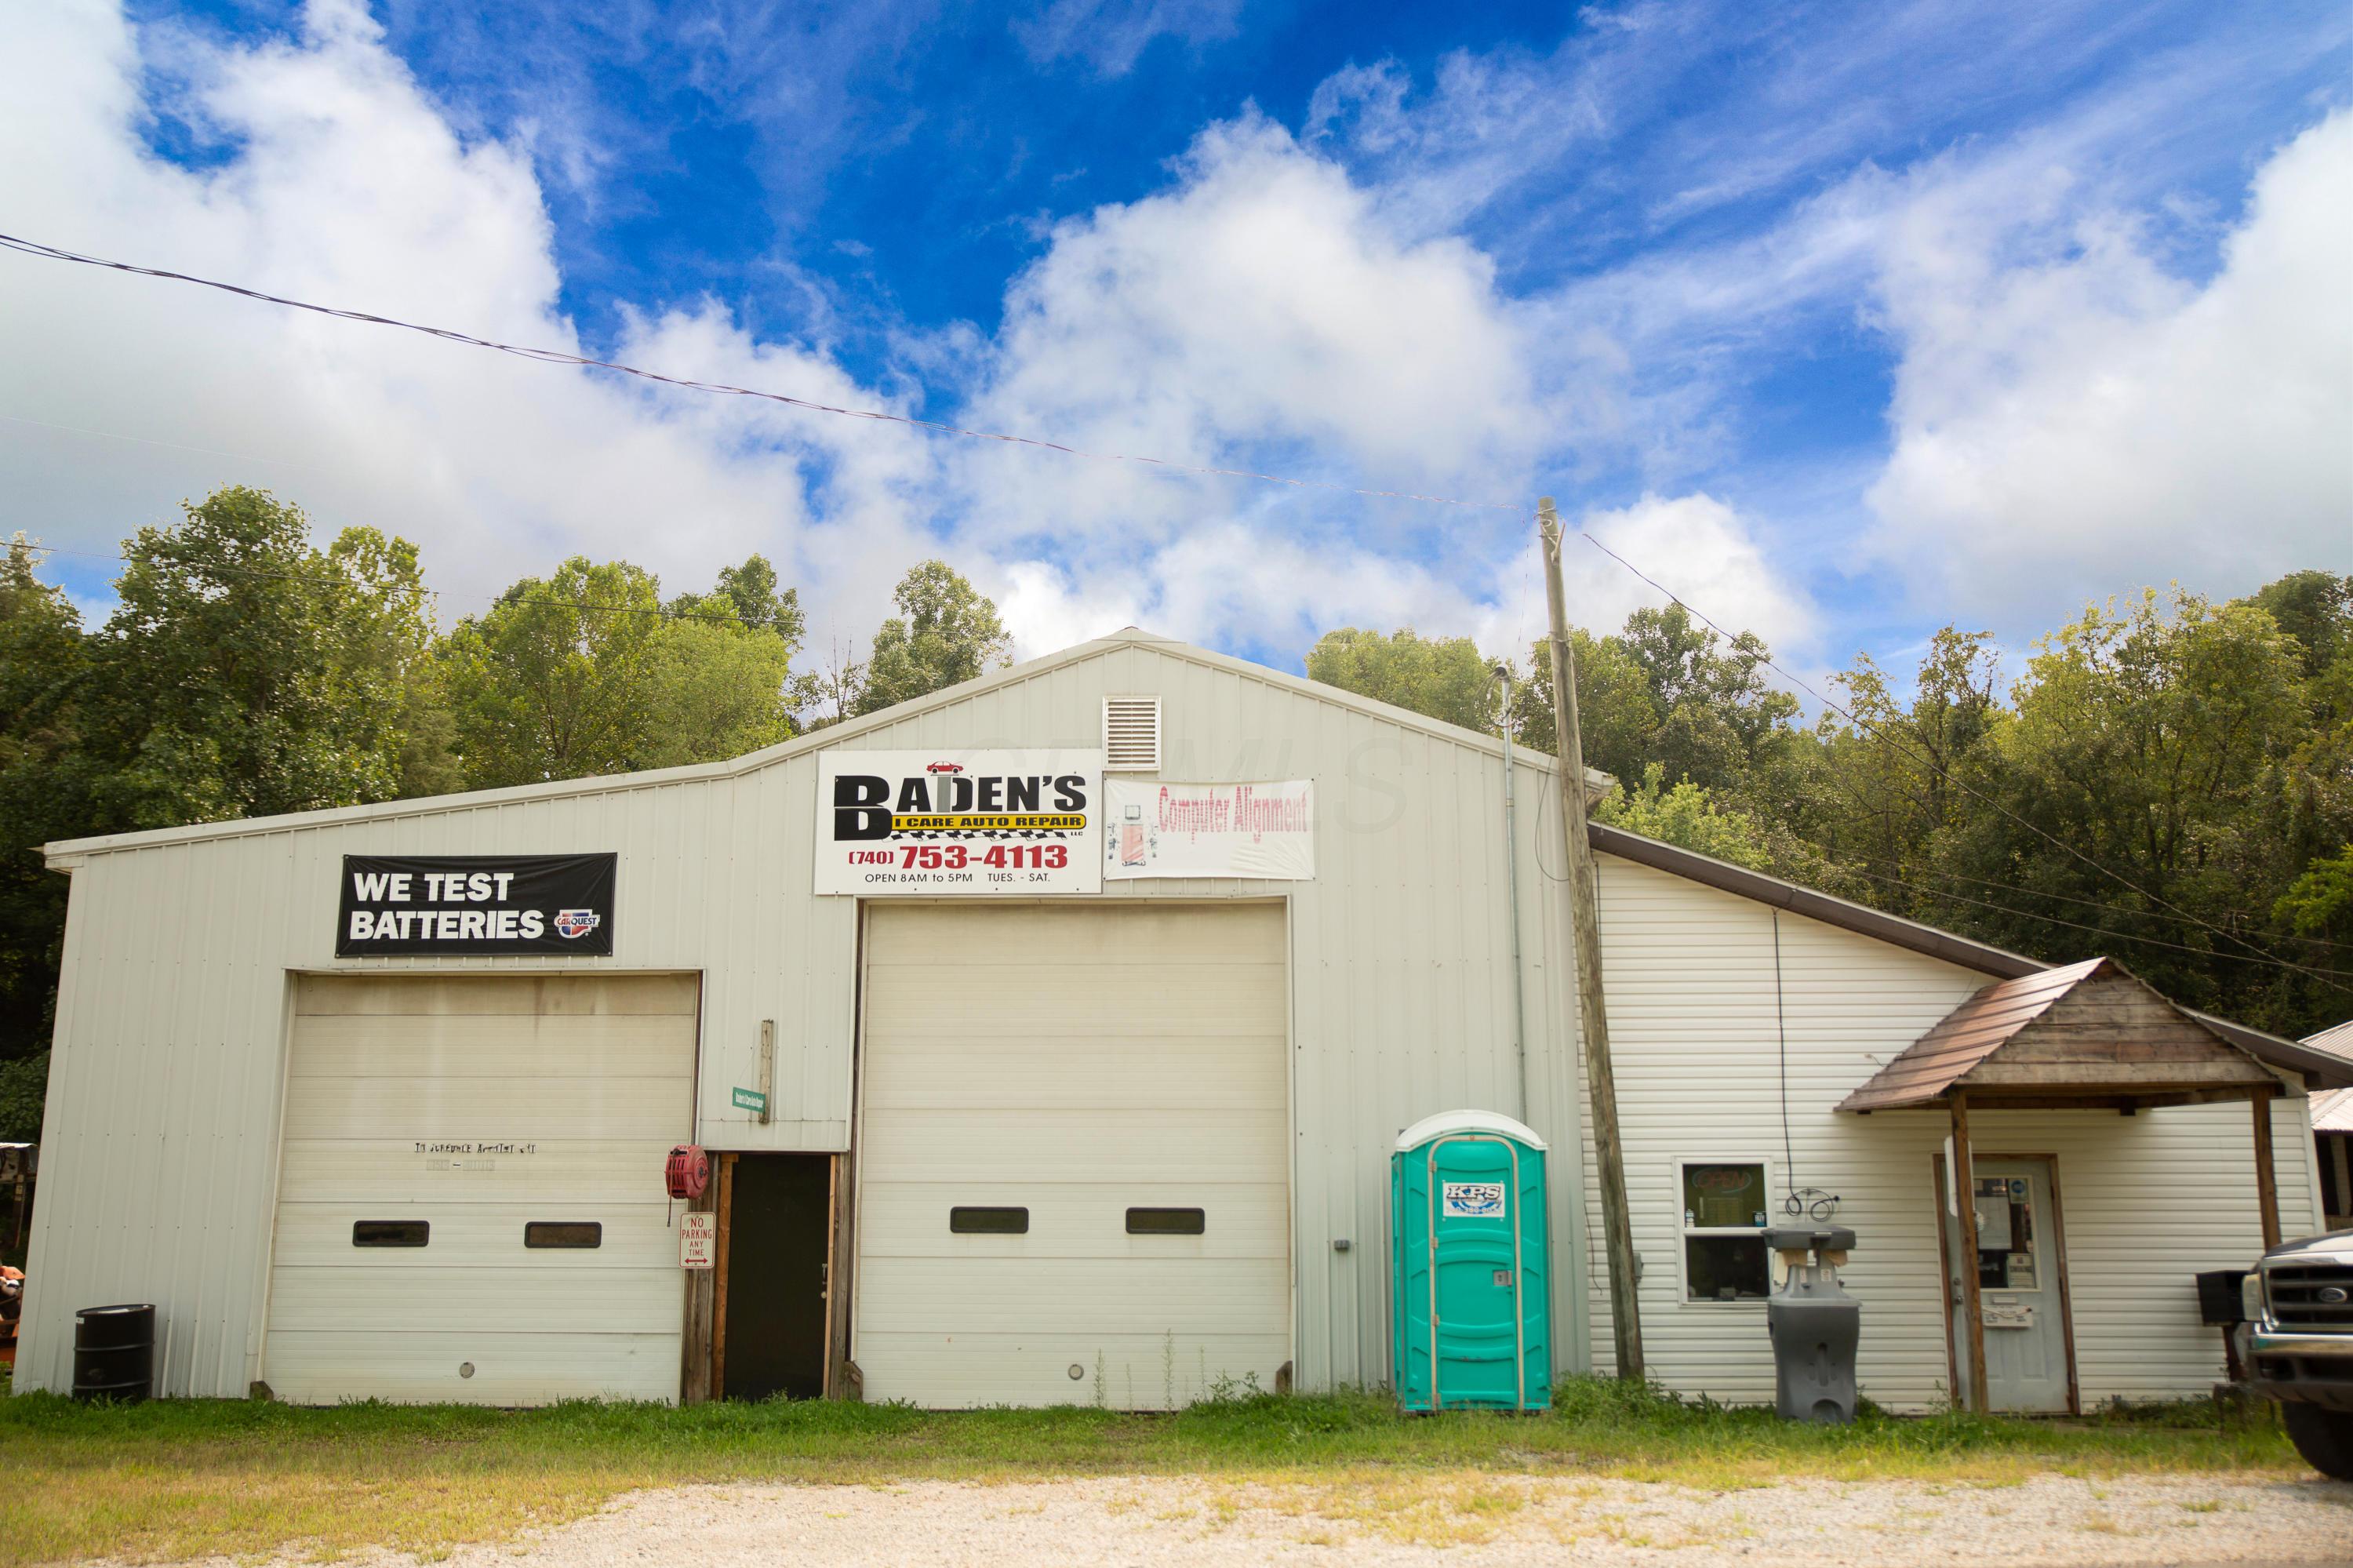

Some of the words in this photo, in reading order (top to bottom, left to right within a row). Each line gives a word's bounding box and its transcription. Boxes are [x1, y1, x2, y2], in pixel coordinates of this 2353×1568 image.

[895, 817, 901, 827] I
[907, 817, 955, 827] CARE
[959, 817, 1009, 827] AUTO
[1015, 817, 1082, 827] REPAIR
[1158, 785, 1230, 845] Computer
[1233, 785, 1308, 845] Alignment
[849, 851, 894, 864] (740)
[900, 845, 1068, 869] 753-4113
[864, 873, 896, 883] OPEN
[933, 873, 944, 882] to
[948, 873, 973, 882] 5PM
[987, 872, 1016, 882] TUES.
[1029, 872, 1051, 882] SAT.
[354, 872, 413, 902] WE
[424, 872, 515, 902] TEST
[350, 910, 544, 940] BATTERIES
[557, 917, 597, 926] CARQUEST
[1697, 1171, 1745, 1188] OPEN
[1446, 1185, 1501, 1200] KPS
[691, 1217, 704, 1228] NO
[682, 1229, 712, 1239] PARKING
